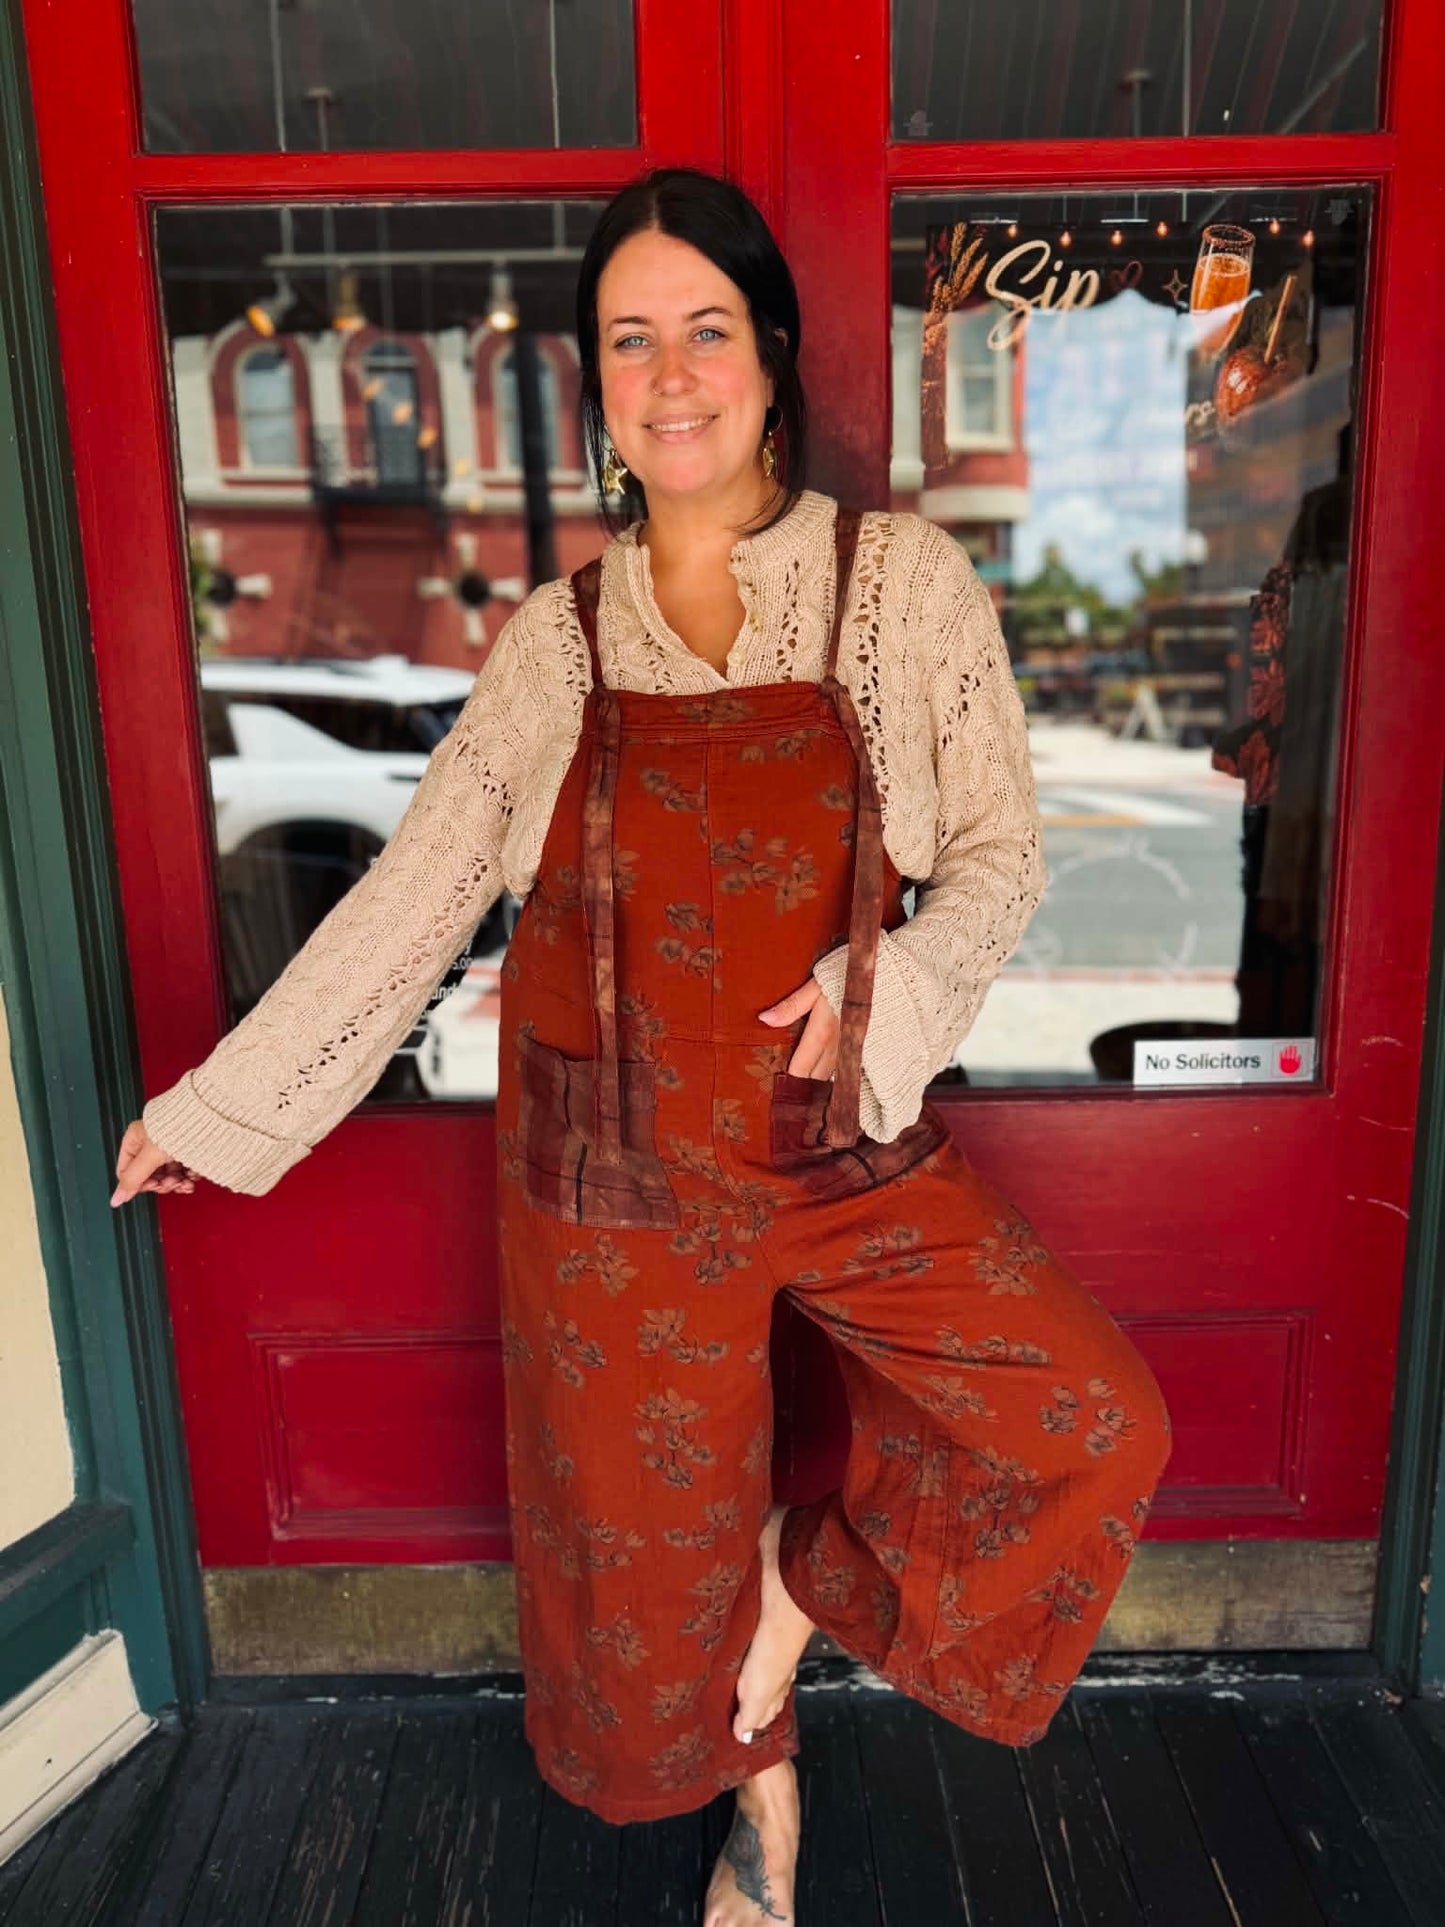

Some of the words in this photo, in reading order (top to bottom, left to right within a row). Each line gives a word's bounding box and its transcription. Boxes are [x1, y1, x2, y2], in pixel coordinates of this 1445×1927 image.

[985, 239, 1100, 351] Sip
[1145, 1054, 1170, 1070] No
[1175, 1052, 1261, 1070] Solicitors
